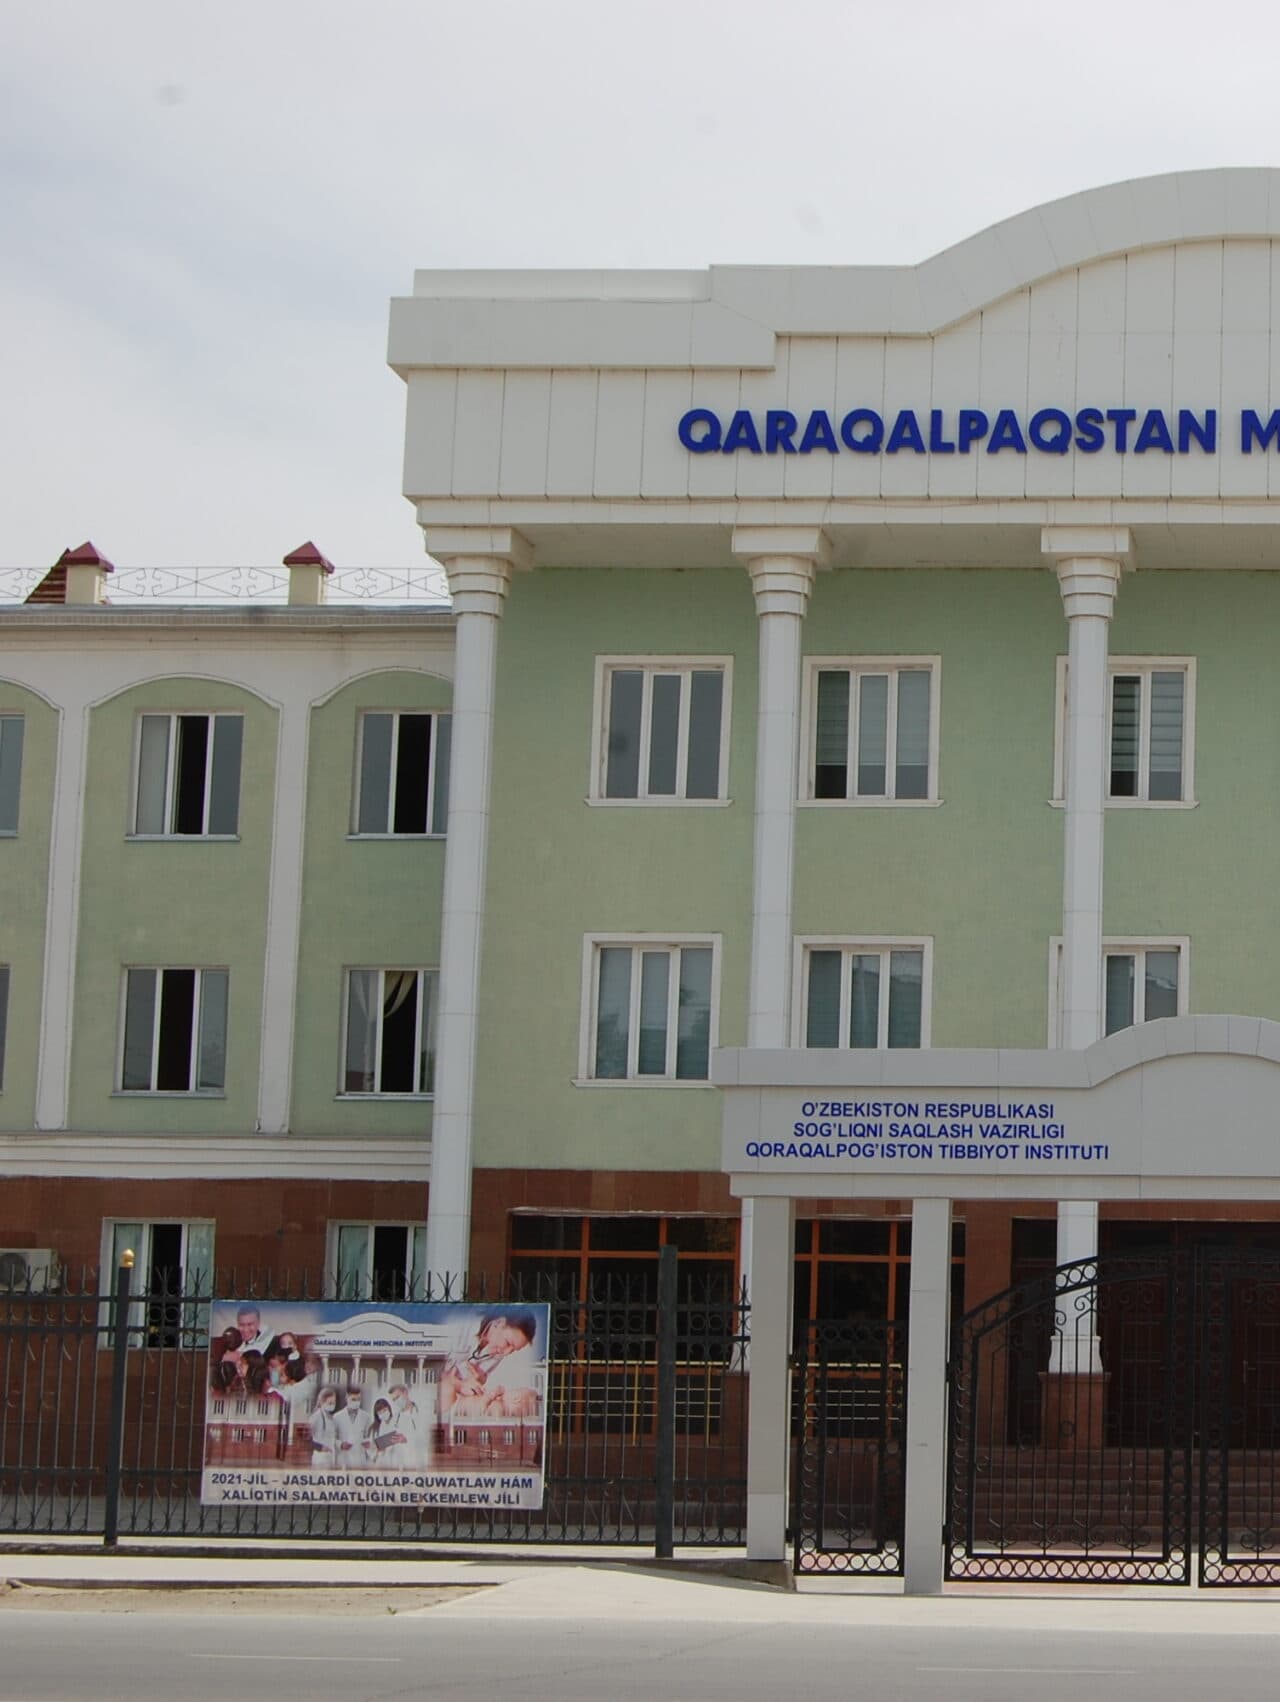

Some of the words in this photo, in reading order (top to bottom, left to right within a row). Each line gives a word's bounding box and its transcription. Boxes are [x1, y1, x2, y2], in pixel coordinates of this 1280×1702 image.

[678, 407, 1217, 453] QARAQALPAQSTAN
[801, 1102, 920, 1118] O'ZBEKISTON
[924, 1102, 1056, 1119] RESPUBLIKASI
[793, 1121, 884, 1138] SOG'LIQNI
[889, 1122, 974, 1139] SAQLASH
[979, 1122, 1066, 1139] VAZIRLIGI
[939, 1143, 1019, 1160] TIBBIYOT
[1024, 1143, 1110, 1160] INSTITUTI
[354, 1475, 496, 1488] QOLLAP-QUWATLAW
[500, 1475, 533, 1489] HÁM
[399, 1491, 490, 1504] BEKKEMLEW
